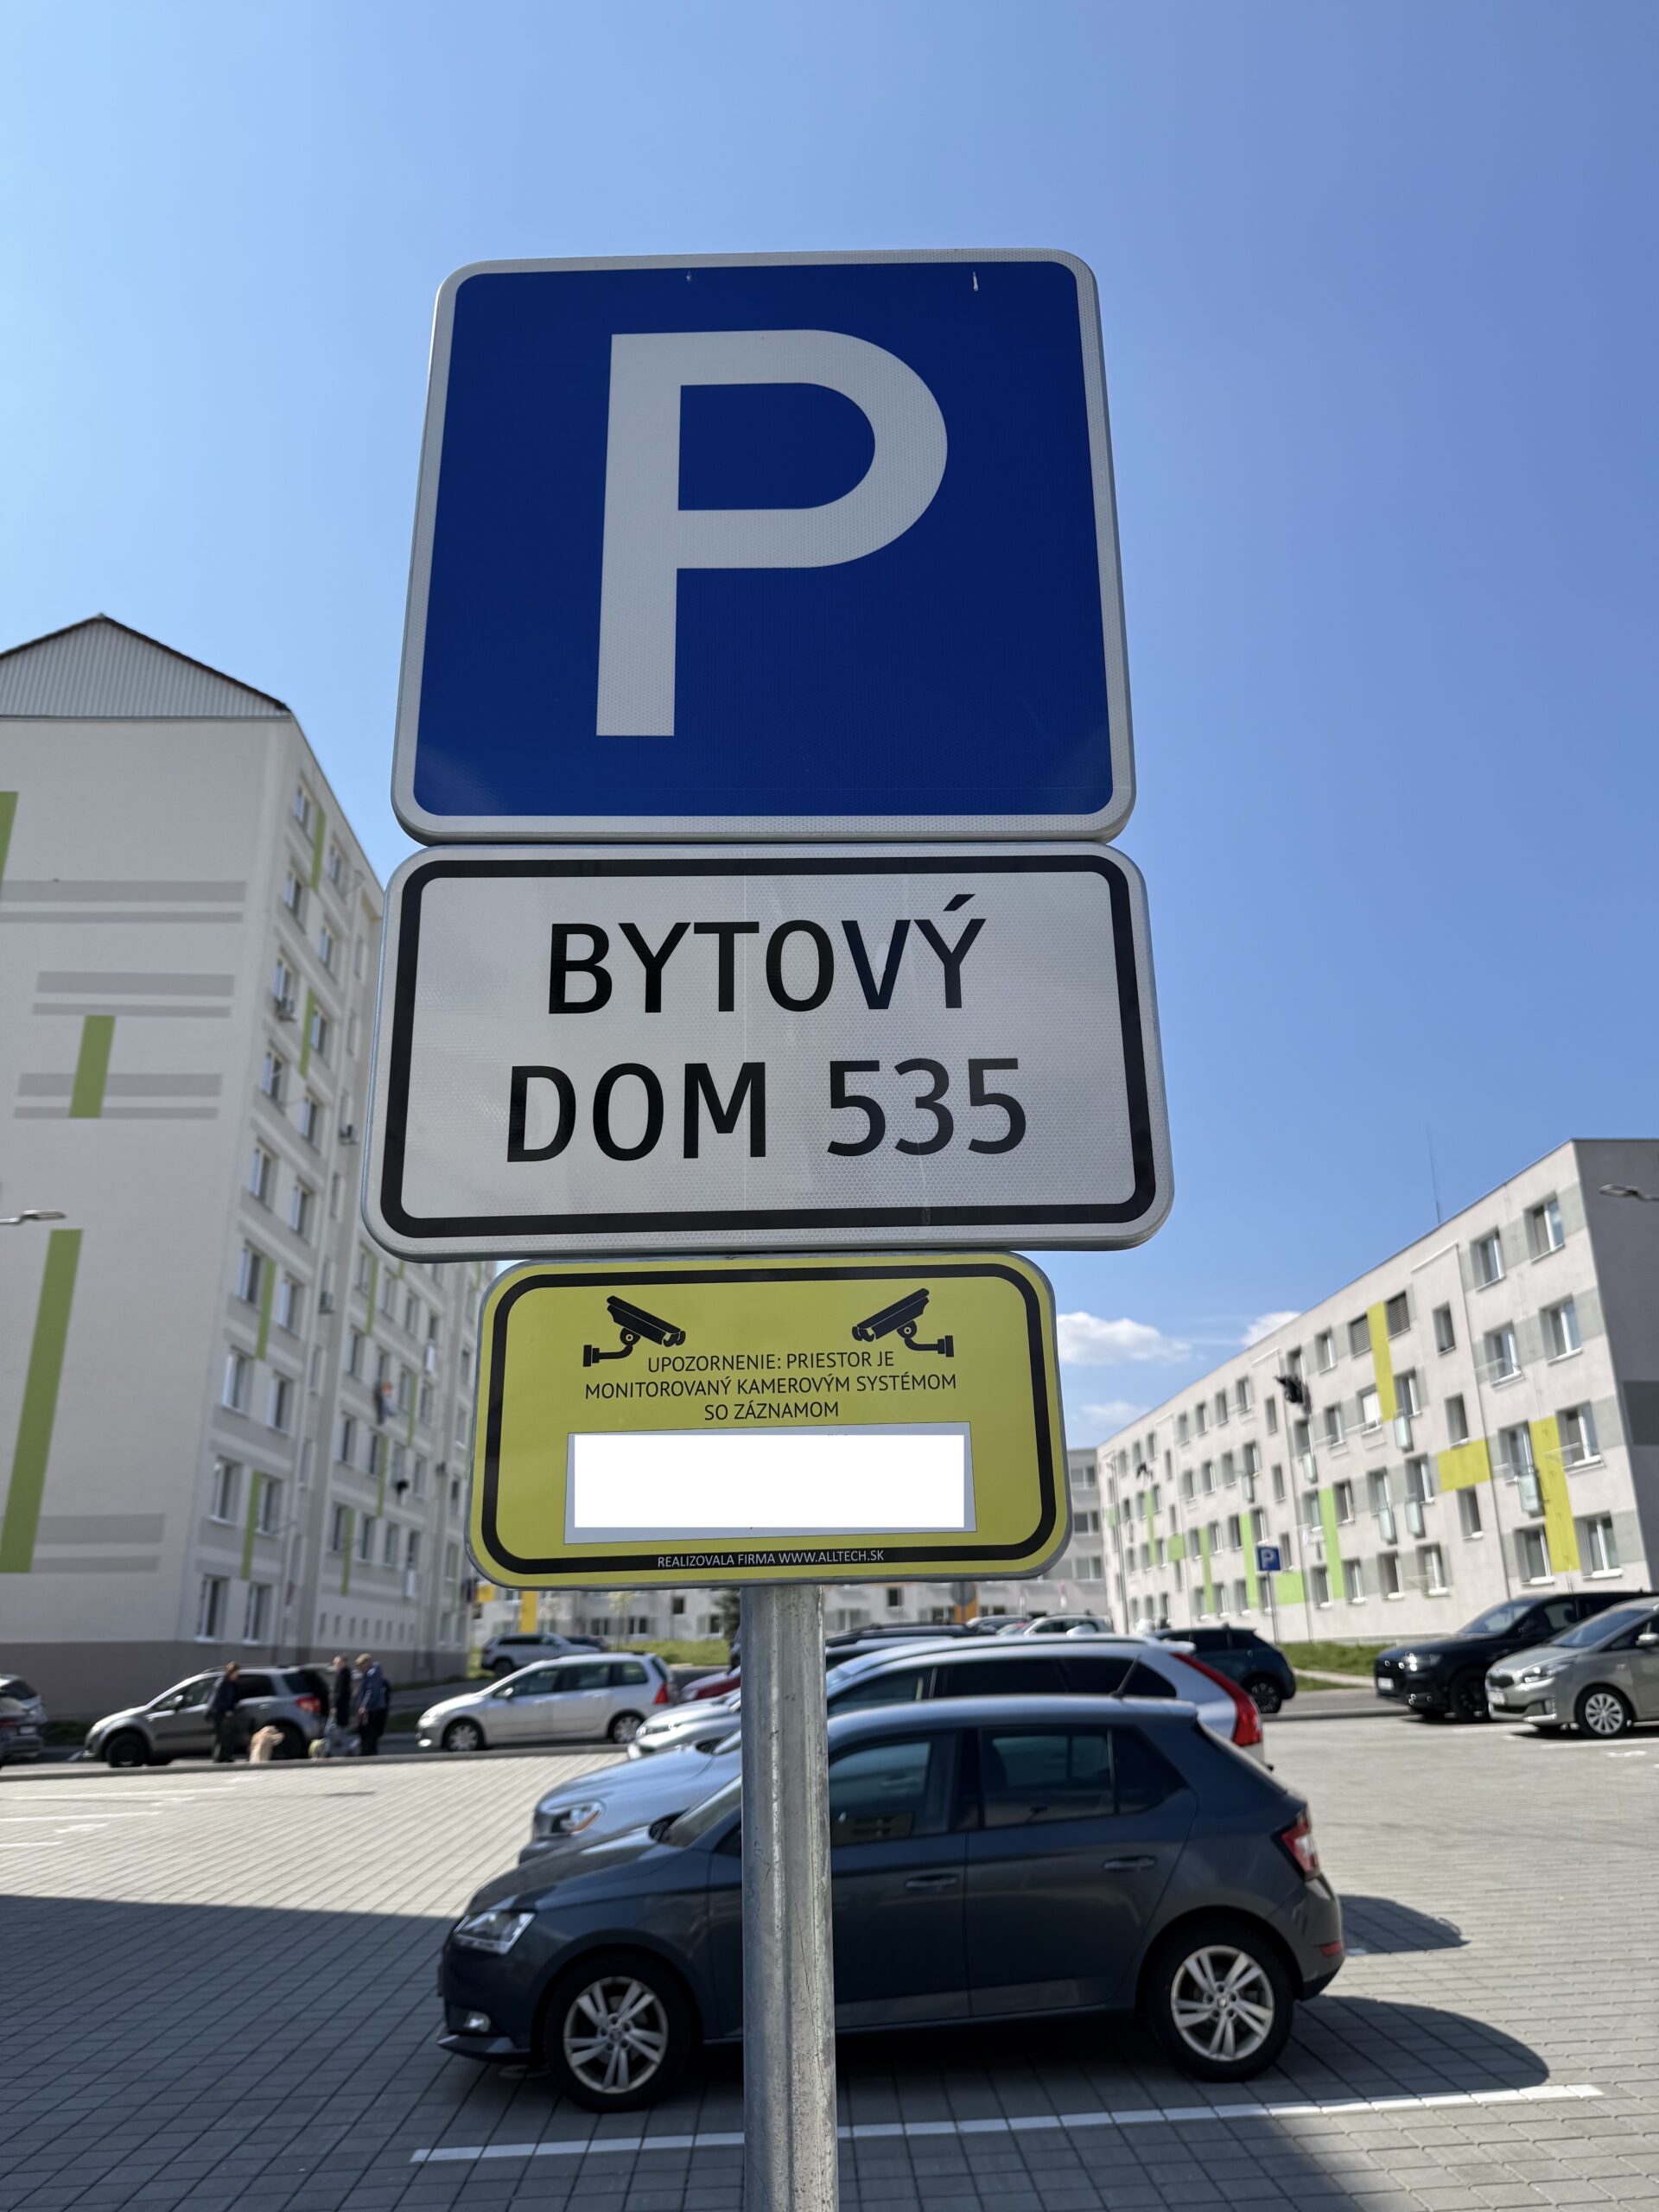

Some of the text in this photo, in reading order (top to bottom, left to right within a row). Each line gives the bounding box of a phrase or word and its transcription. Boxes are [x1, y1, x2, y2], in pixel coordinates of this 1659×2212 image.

[596, 330, 948, 736] P
[549, 894, 986, 1014] BYTOVÝ
[507, 1058, 1026, 1162] DOM 535
[648, 1351, 894, 1373] UPOZORNENIE: PRIESTOR JE
[585, 1372, 957, 1400] MONITOROVANÝ KAMEROVÝM SYSTÉMOM
[704, 1400, 839, 1421] SO ZÁZNAMOM
[658, 1549, 885, 1567] REALIZOVALA FIRMA WWW.ALLTECH.SK
[1261, 1548, 1274, 1570] P
